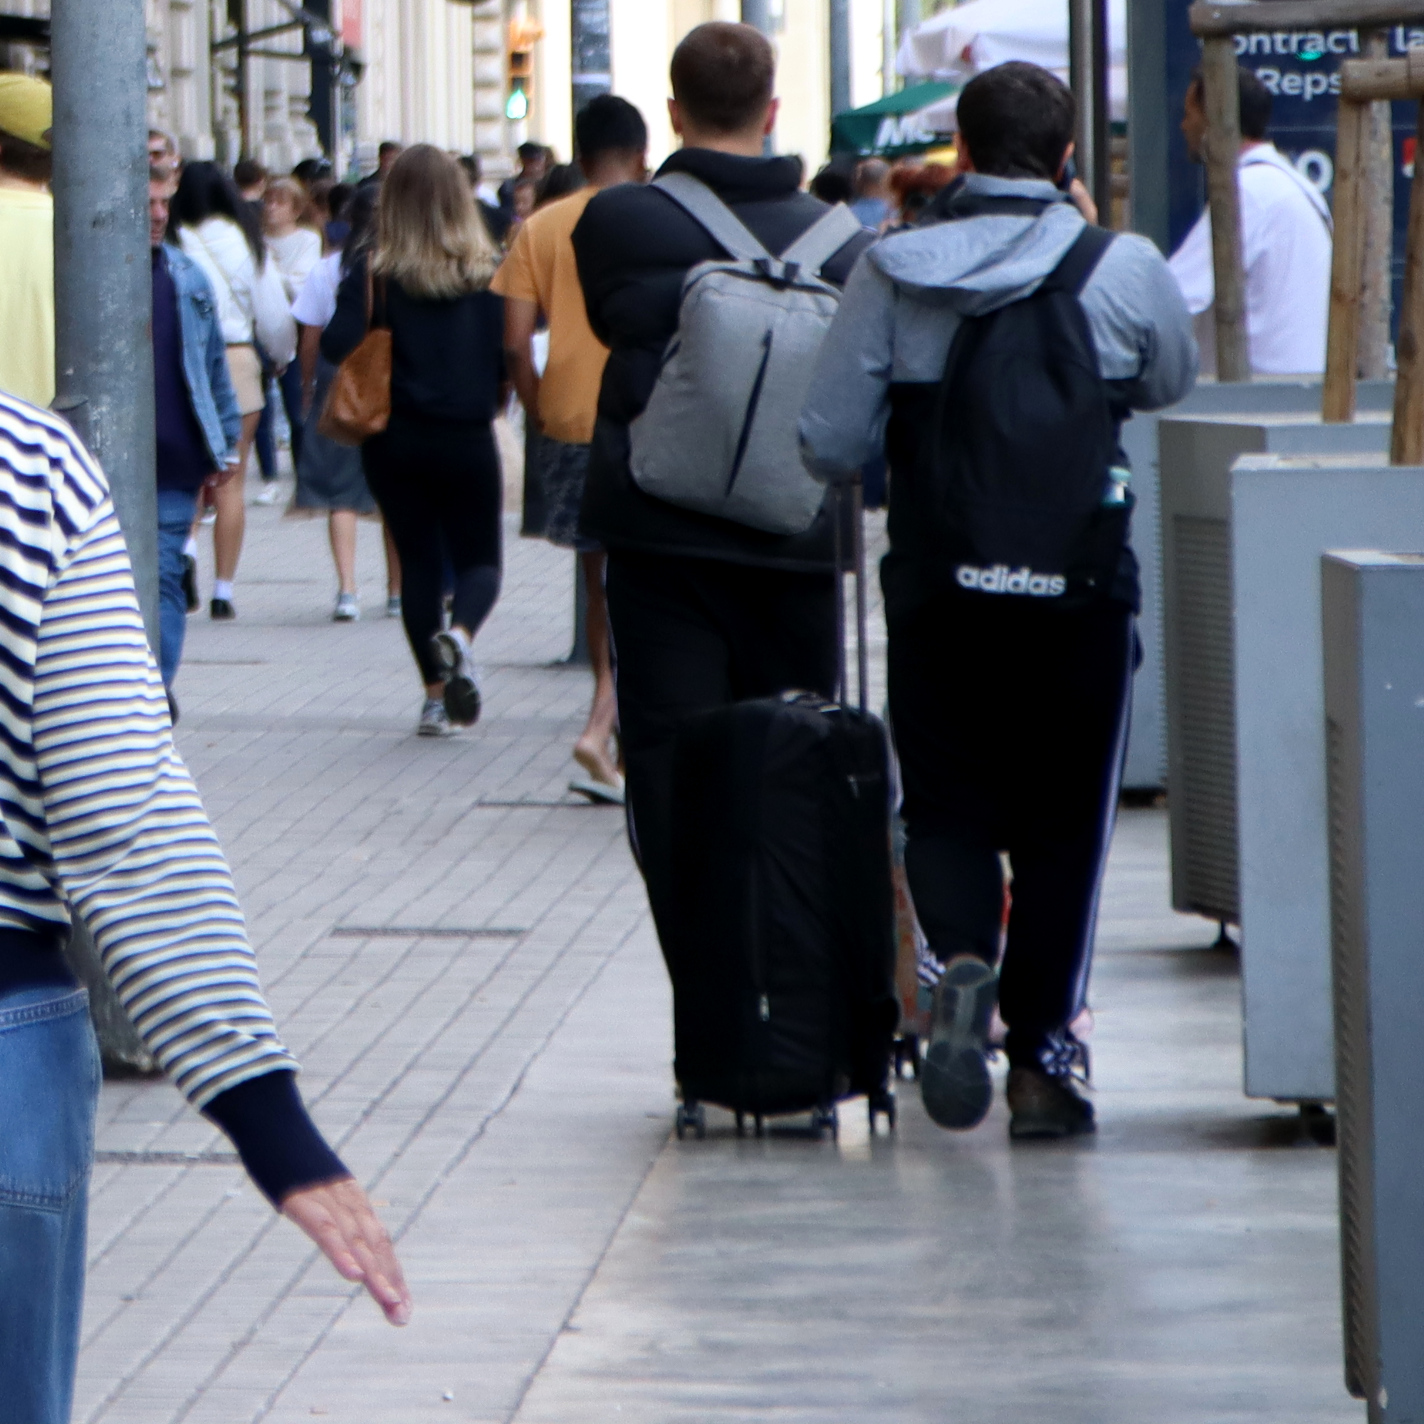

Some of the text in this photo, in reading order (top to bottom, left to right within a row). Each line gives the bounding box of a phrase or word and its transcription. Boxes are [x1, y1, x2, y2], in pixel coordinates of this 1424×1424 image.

[1232, 29, 1359, 55] ontract
[1255, 67, 1342, 101] Reps
[956, 564, 1067, 596] adidas
